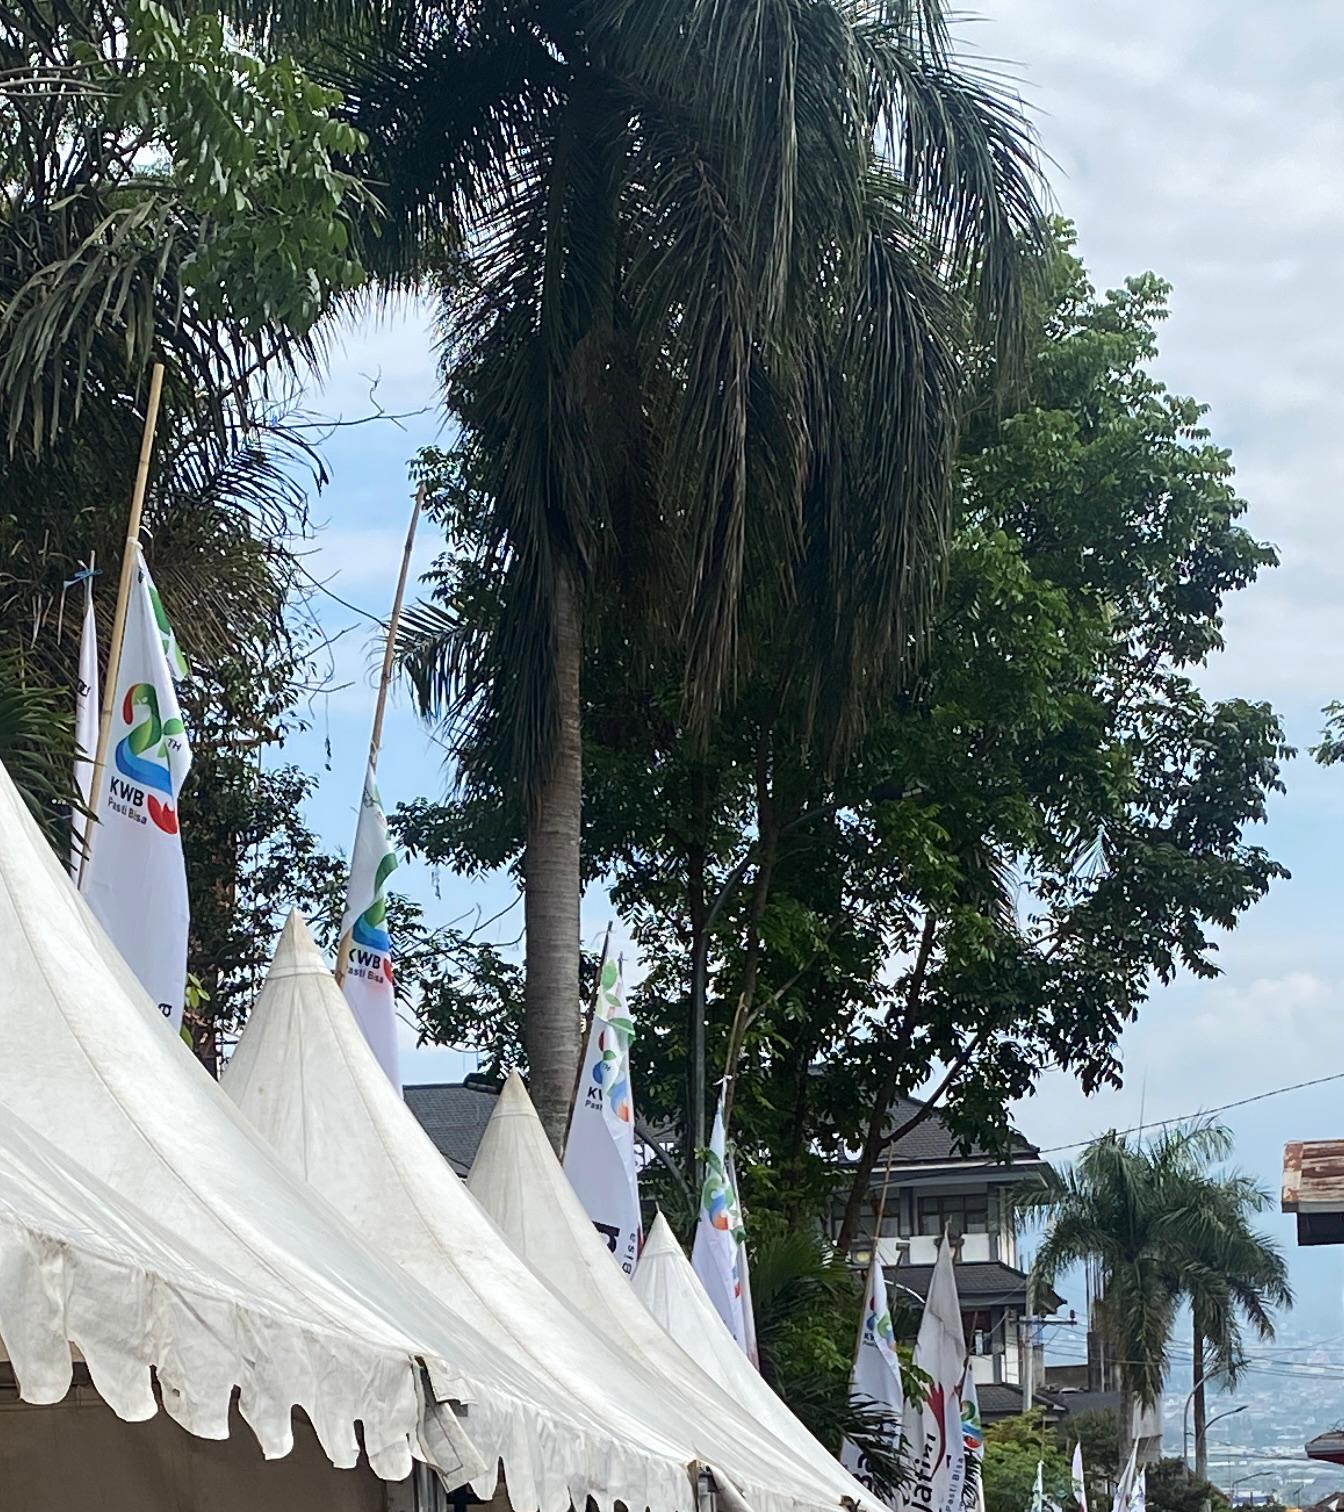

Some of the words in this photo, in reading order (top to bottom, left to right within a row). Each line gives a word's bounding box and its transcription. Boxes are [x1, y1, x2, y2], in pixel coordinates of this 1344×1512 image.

[110, 776, 145, 807] KWB
[108, 797, 128, 816] Pasti
[128, 807, 148, 825] Bisa
